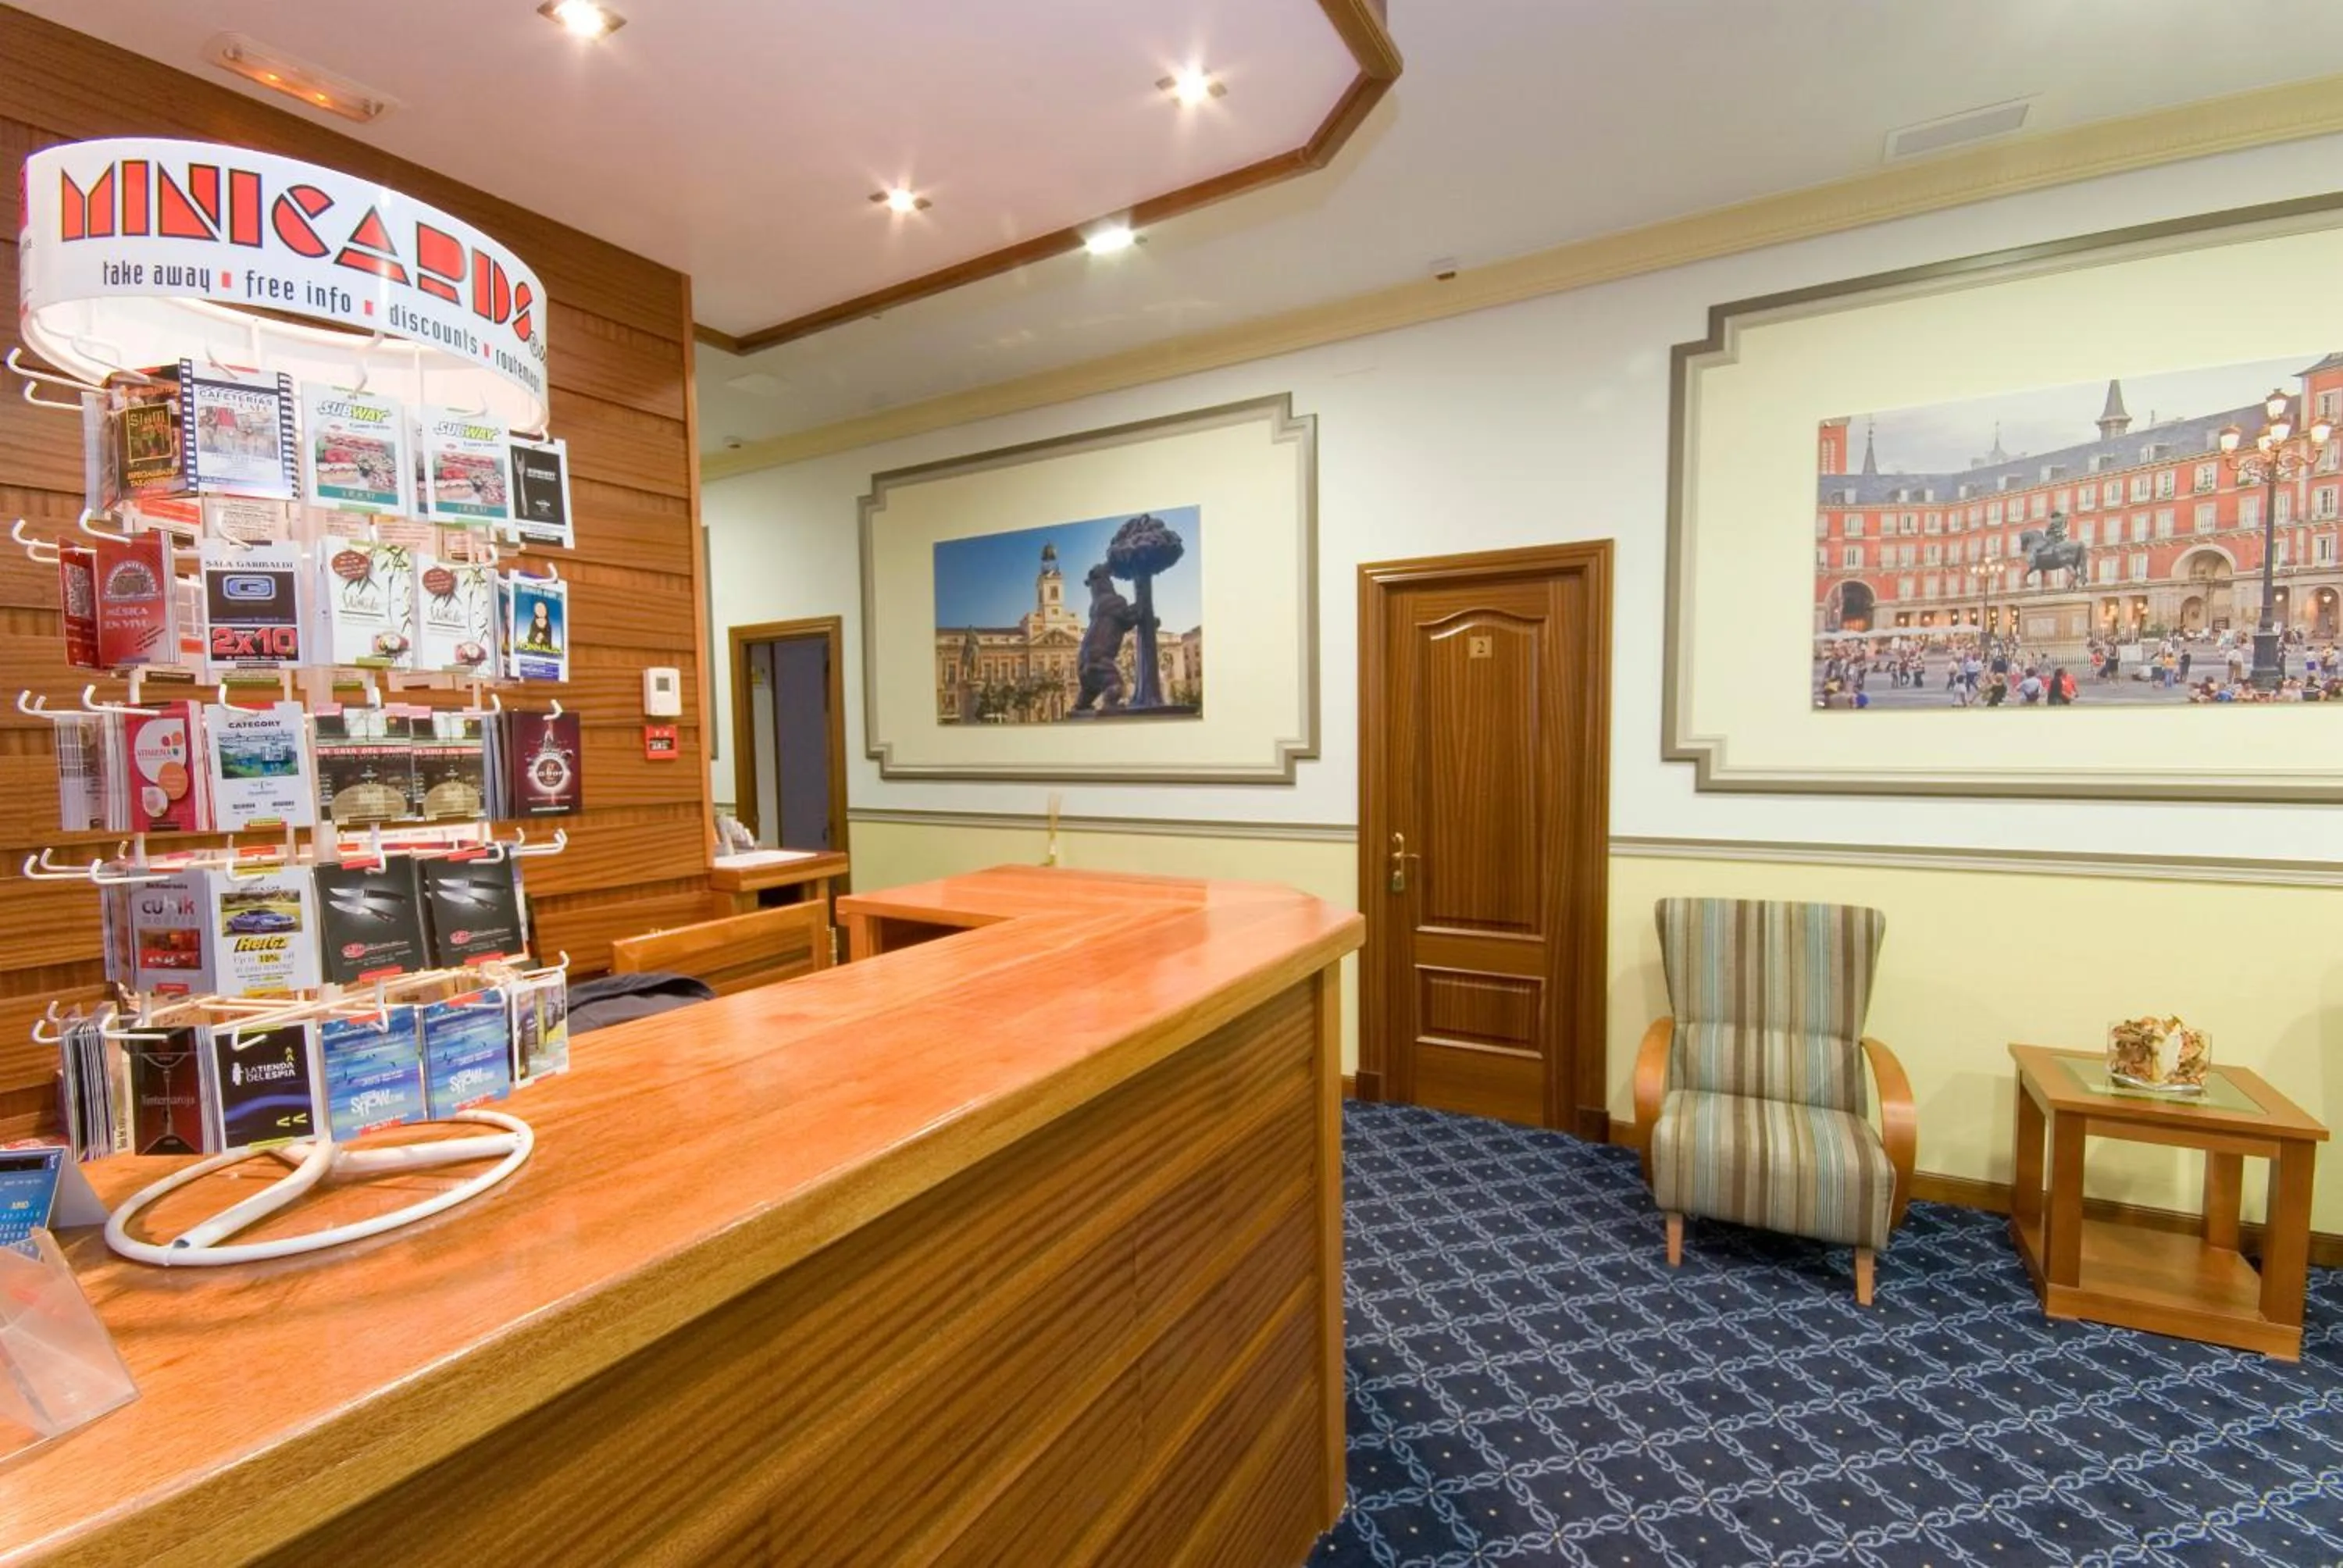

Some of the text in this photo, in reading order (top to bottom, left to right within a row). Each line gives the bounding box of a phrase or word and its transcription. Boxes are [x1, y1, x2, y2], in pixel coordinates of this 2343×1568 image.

[61, 159, 533, 343] MINICARDS
[103, 260, 144, 286] take
[153, 264, 211, 294] away
[245, 270, 294, 302] free
[306, 279, 351, 314] info
[390, 304, 478, 355] discounts
[316, 400, 393, 423] SUBWAY
[433, 420, 501, 443] SUBWAY
[1477, 641, 1485, 654] 2
